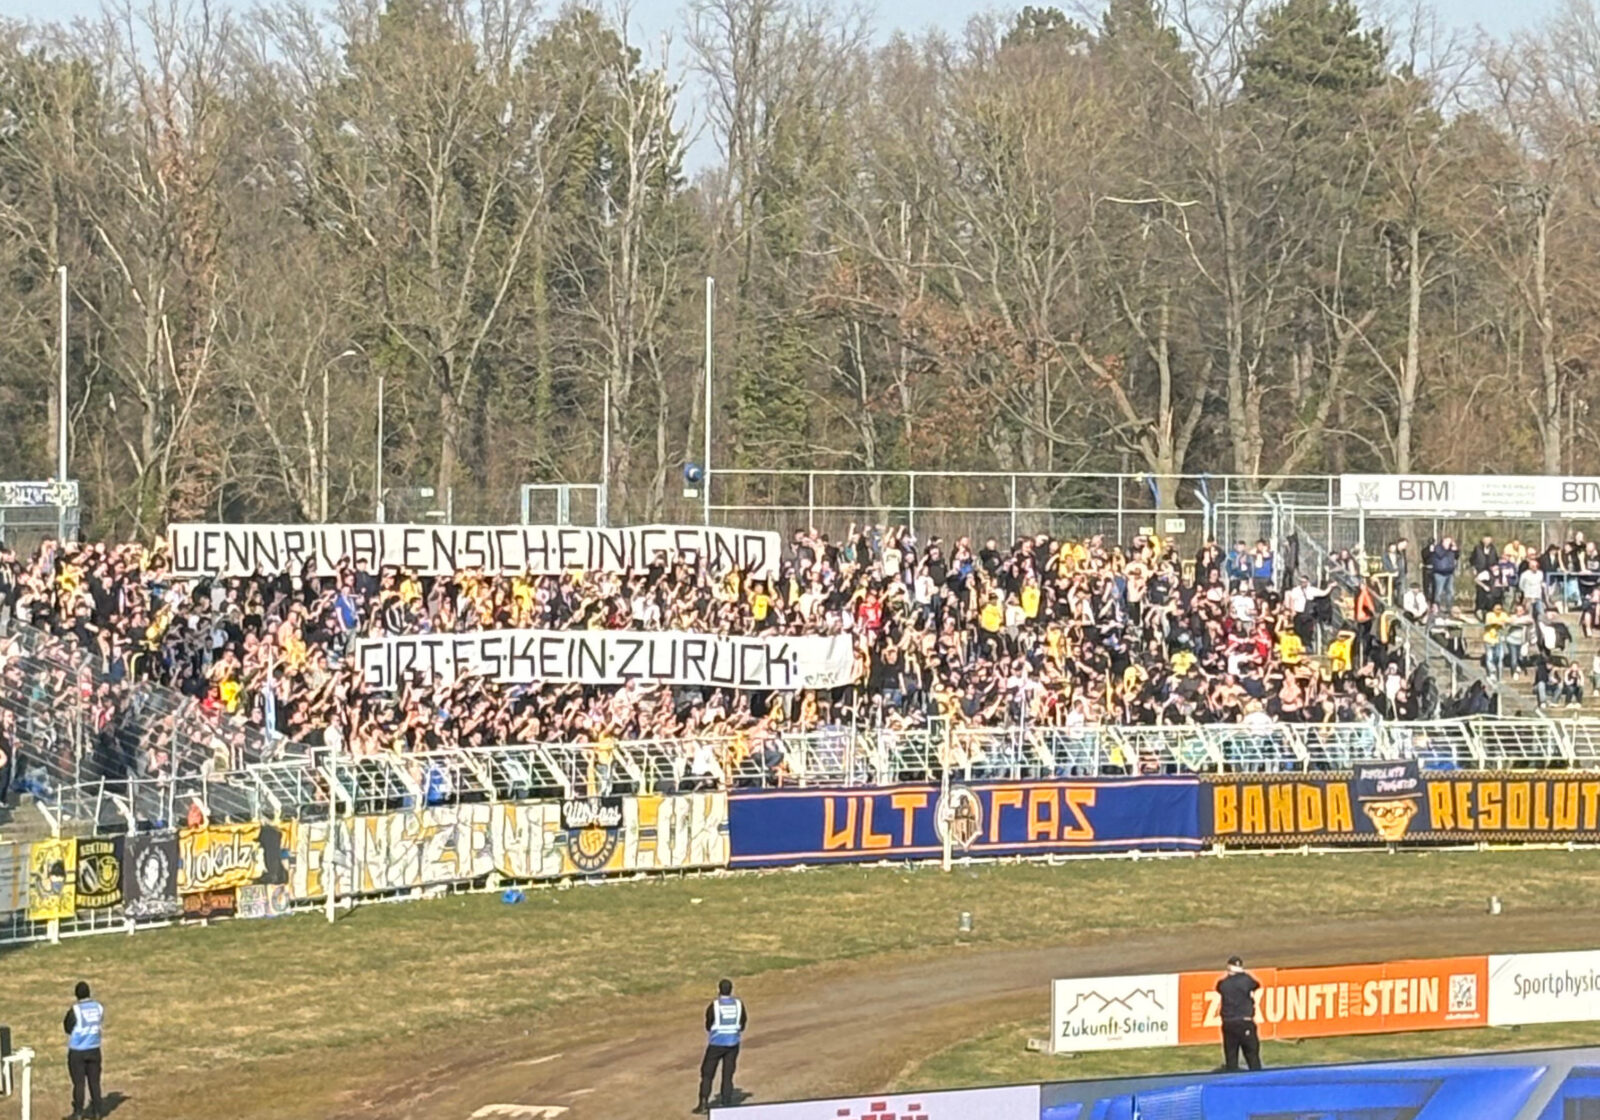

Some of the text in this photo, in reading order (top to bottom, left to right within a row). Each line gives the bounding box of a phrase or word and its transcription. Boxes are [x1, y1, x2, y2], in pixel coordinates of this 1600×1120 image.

[1399, 480, 1449, 501] BTM
[1213, 782, 1354, 834] BANDA
[1203, 983, 1338, 1027] ZKUNFT
[1363, 977, 1439, 1016] STEIN
[1061, 1016, 1168, 1037] Zukunft-Steine
